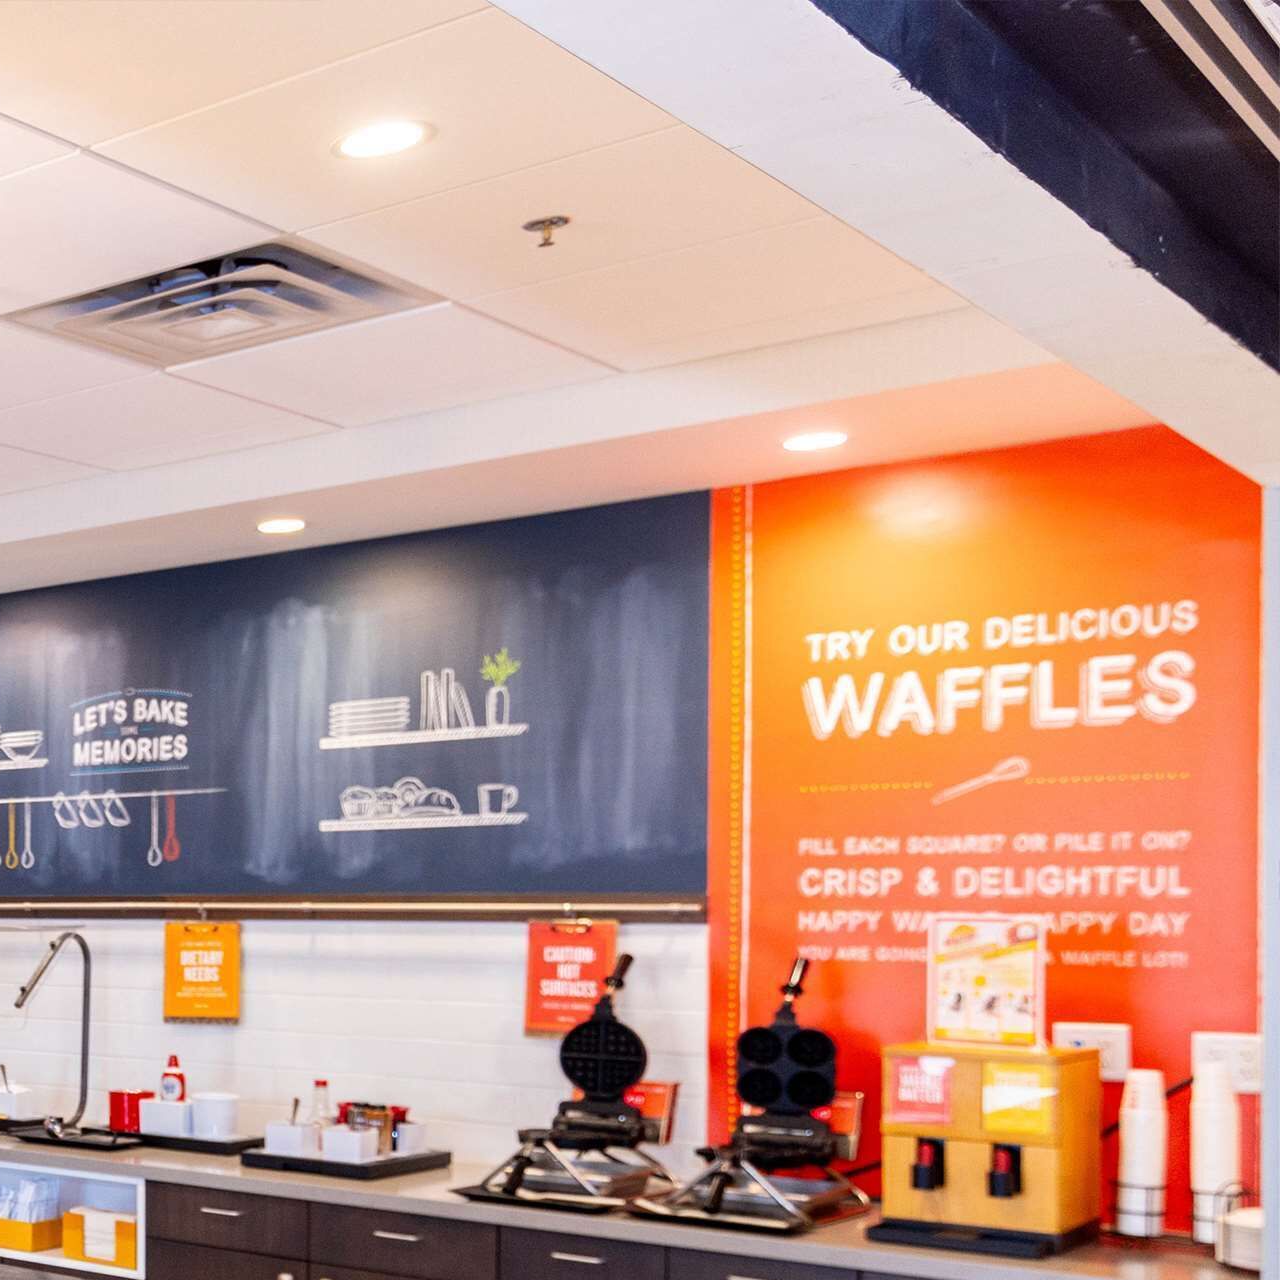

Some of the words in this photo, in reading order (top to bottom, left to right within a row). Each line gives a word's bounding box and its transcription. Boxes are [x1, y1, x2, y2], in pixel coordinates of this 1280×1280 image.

[805, 629, 876, 662] TRY
[888, 620, 970, 656] OUR
[983, 599, 1199, 648] DELICIOUS
[801, 650, 1197, 740] WAFFLES
[72, 699, 127, 736] LET'S
[133, 698, 189, 727] BAKE
[73, 734, 189, 767] MEMORIES
[798, 838, 839, 856] FILL
[844, 836, 900, 856] EACH
[906, 834, 1005, 855] SQUARE?
[1013, 834, 1048, 853] OR
[1054, 833, 1103, 853] PILE
[1111, 832, 1134, 851] IT
[1142, 831, 1192, 851] ON?
[799, 867, 902, 898] CRISP
[915, 867, 940, 897] &
[954, 866, 1191, 899] DELIGHTFUL
[797, 910, 884, 932] HAPPY
[1041, 911, 1118, 934] APPY
[1128, 911, 1191, 936] DAY
[797, 946, 833, 960] YOU
[835, 946, 870, 961] ARE
[1060, 950, 1137, 968] WAFFLE
[183, 967, 220, 983] NEEDS
[556, 963, 581, 980] HOT
[540, 979, 597, 998] SURFACES
